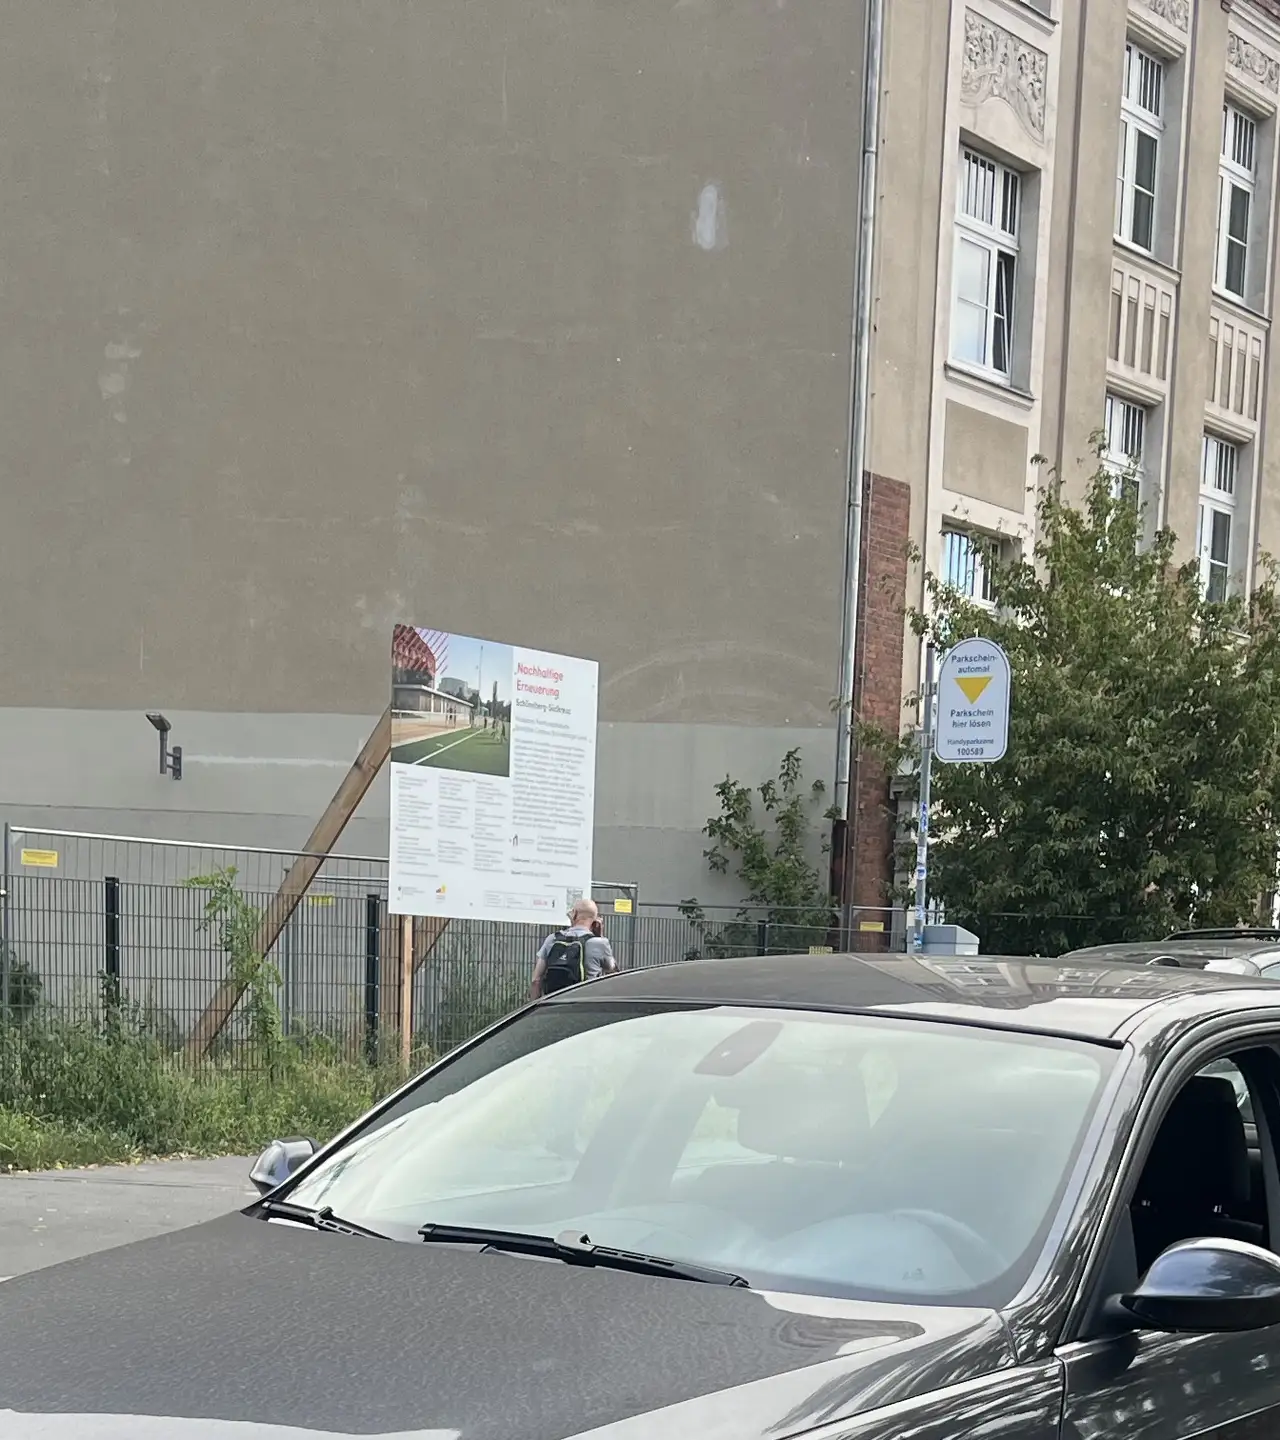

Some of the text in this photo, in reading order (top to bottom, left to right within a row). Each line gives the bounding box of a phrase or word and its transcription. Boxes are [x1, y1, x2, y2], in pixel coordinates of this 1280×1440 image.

[951, 654, 998, 664] Parkschein-
[957, 665, 991, 673] automat
[516, 679, 560, 700] Erneuerung
[950, 708, 994, 717] Parkschein
[952, 719, 991, 728] hier lösen
